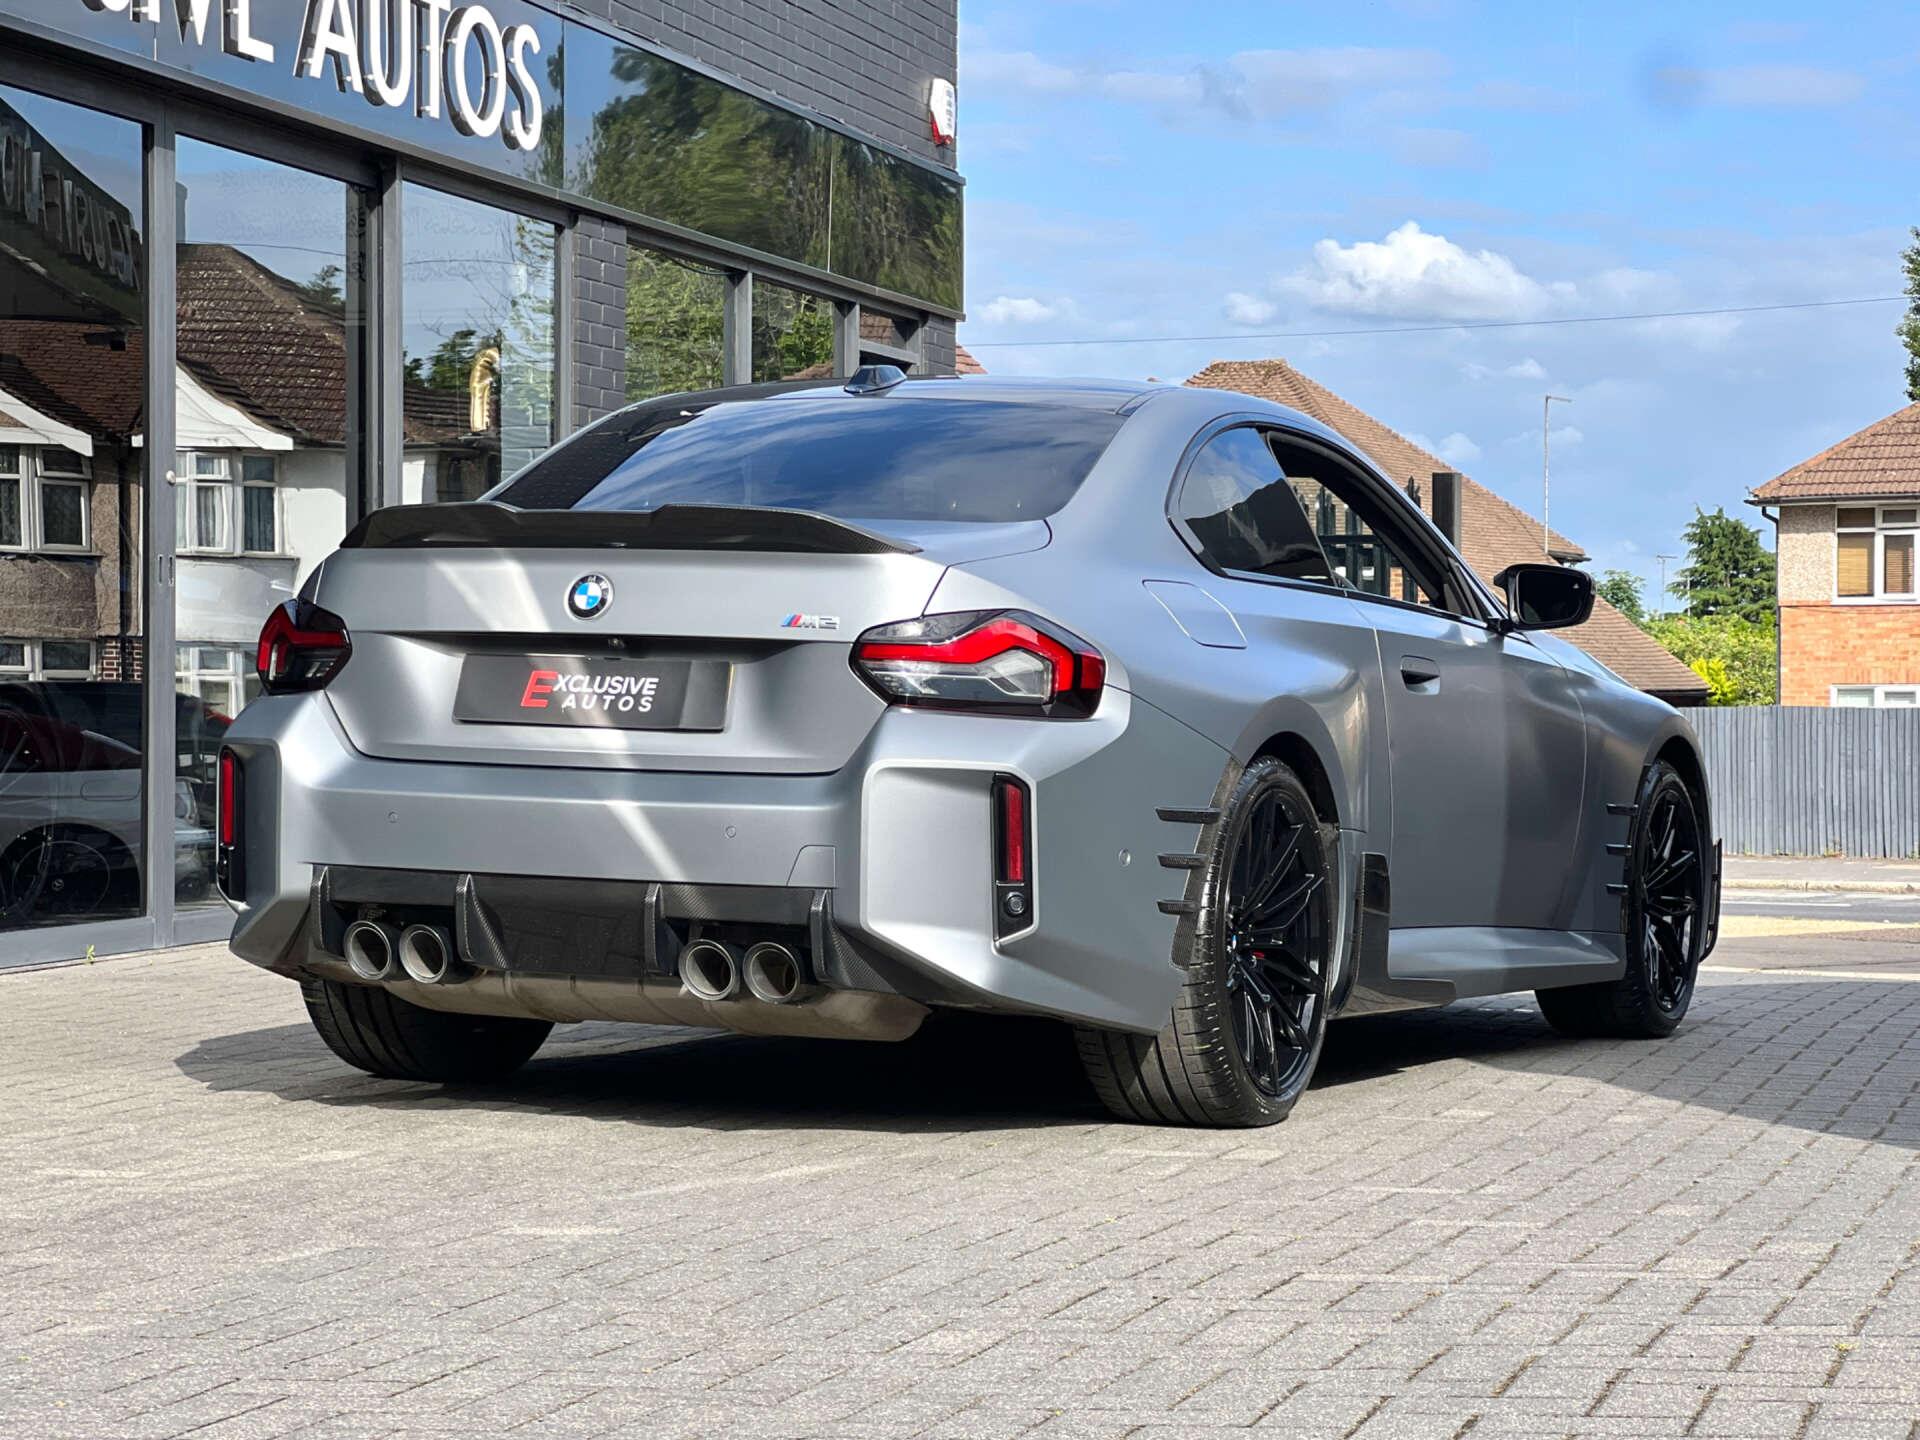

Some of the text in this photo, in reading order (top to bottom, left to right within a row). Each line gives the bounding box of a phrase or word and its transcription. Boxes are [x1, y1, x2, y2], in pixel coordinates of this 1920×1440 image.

[293, 0, 542, 151] AUTOS
[520, 670, 659, 708] EXCLUSIVE
[561, 693, 653, 712] AUTOS
